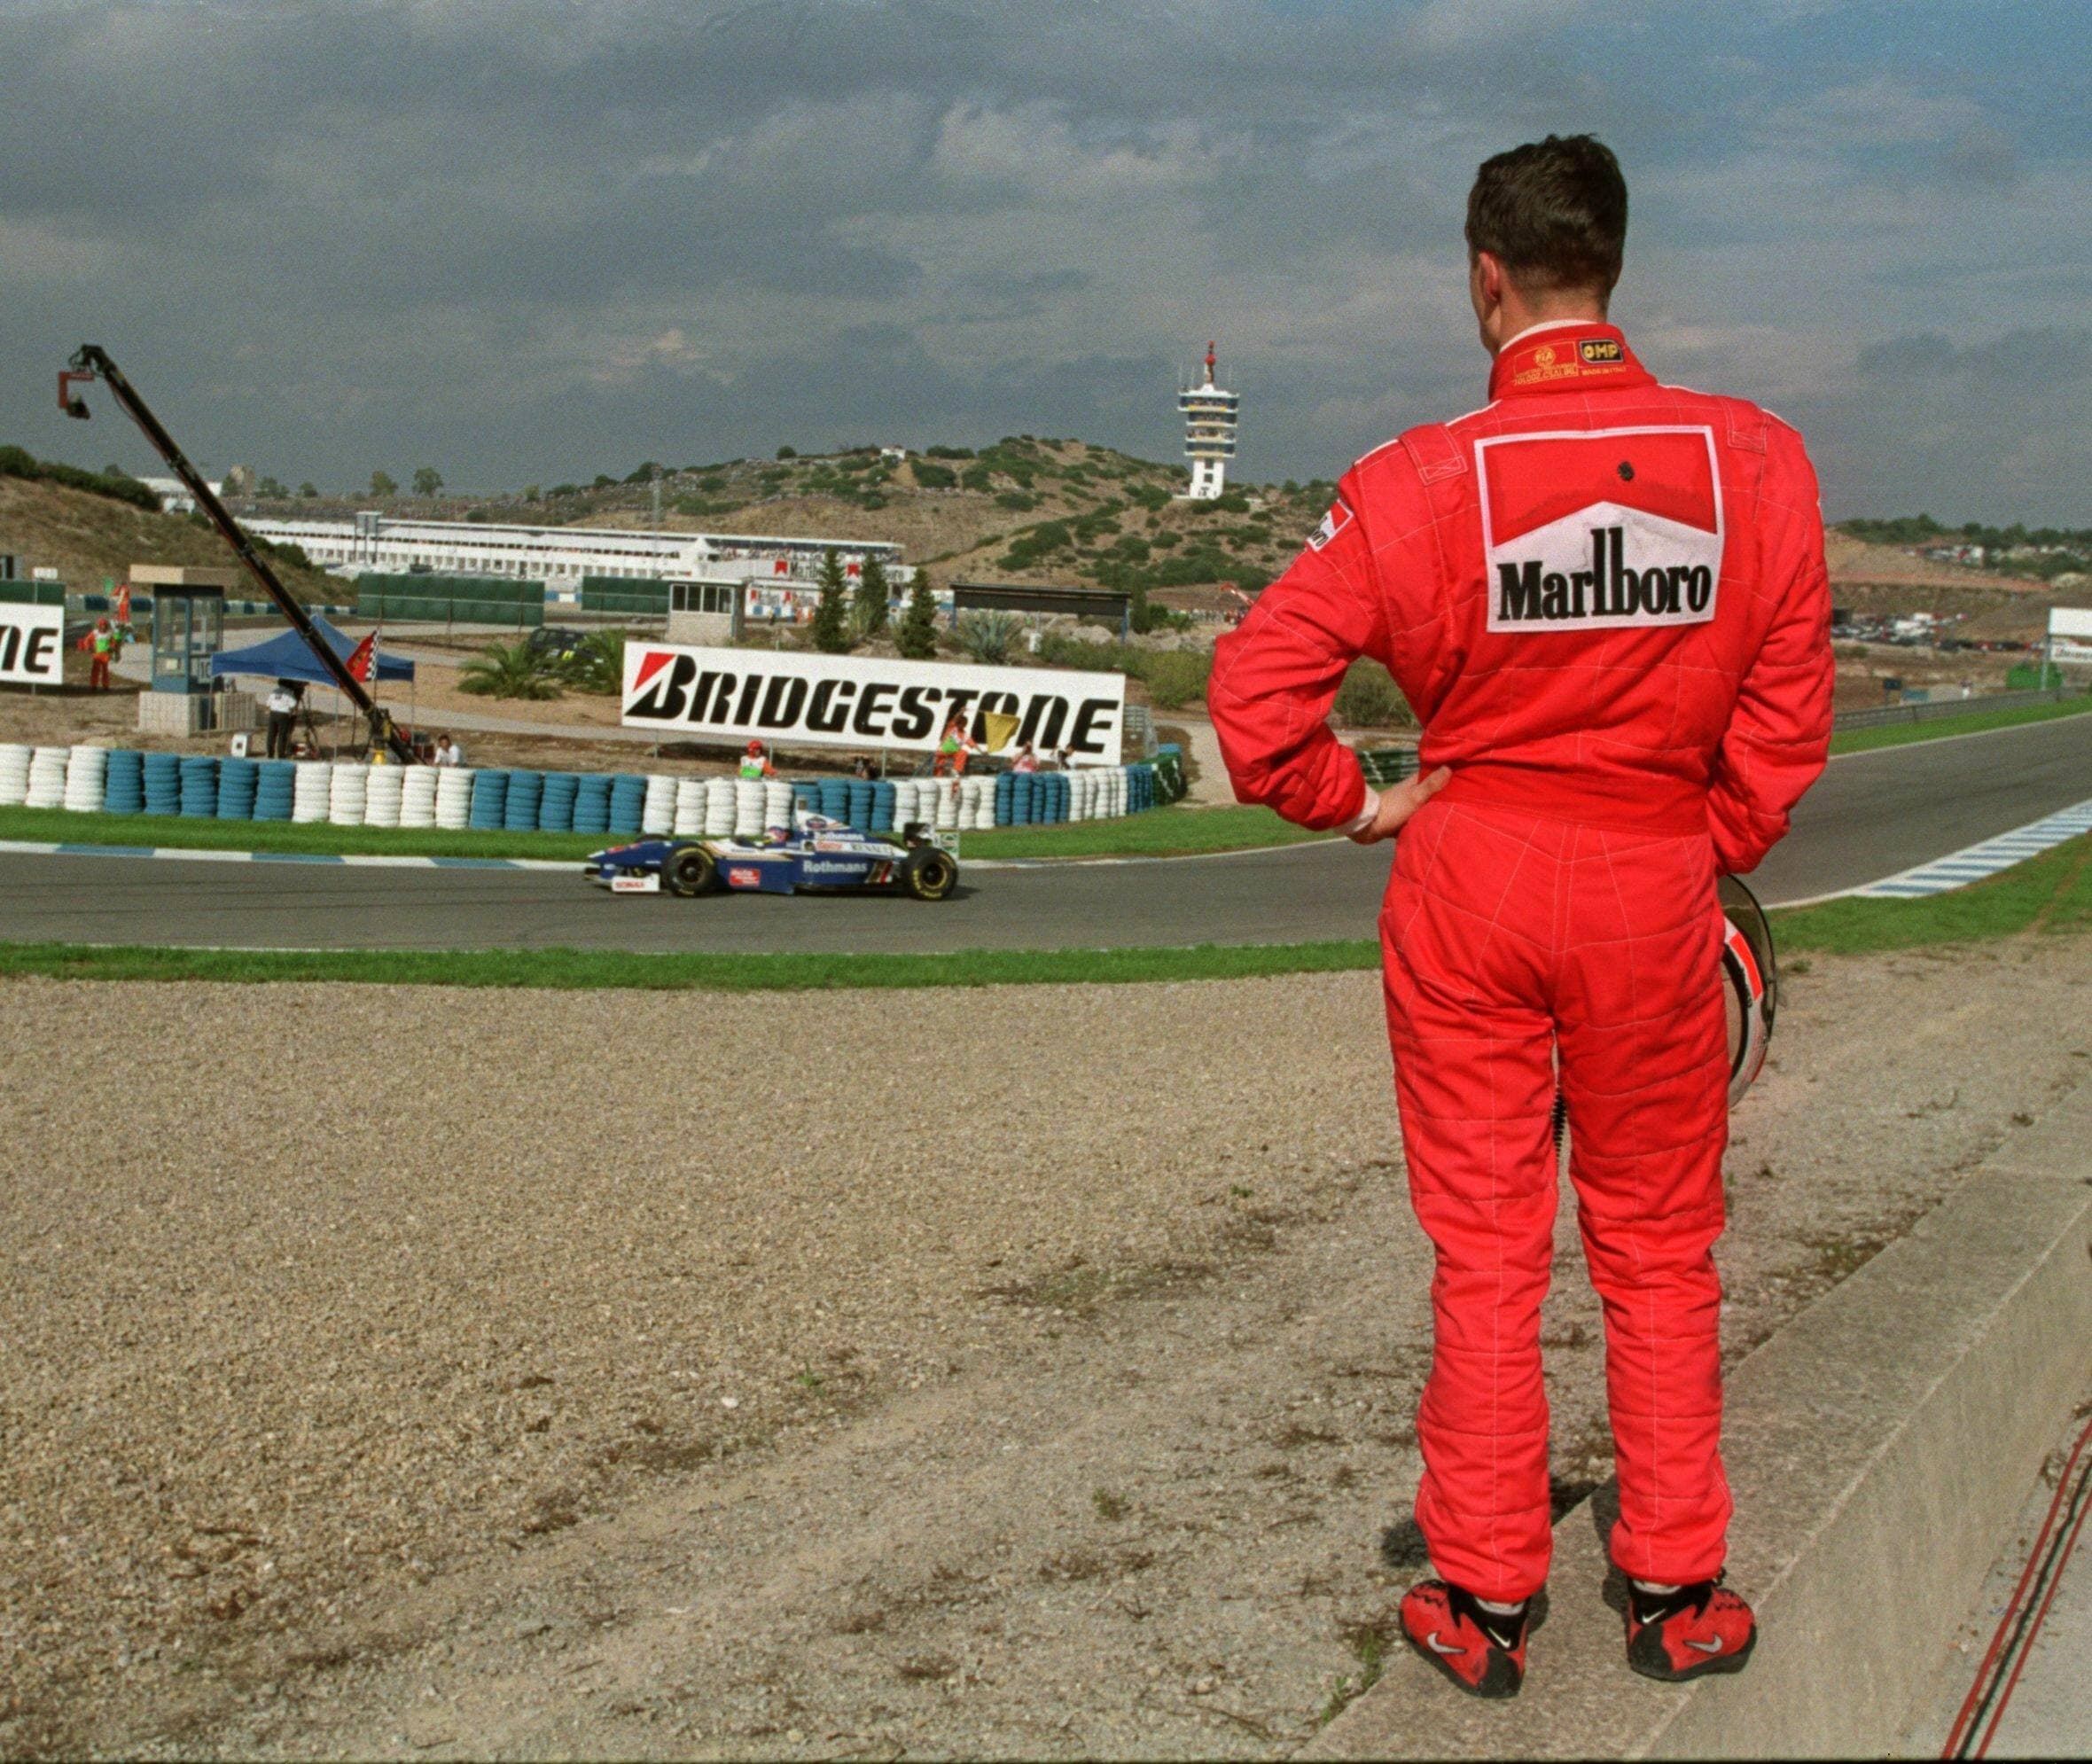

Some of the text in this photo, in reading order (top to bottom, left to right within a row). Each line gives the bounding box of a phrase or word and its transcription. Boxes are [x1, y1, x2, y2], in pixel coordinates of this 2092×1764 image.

[1583, 344, 1619, 359] OMP
[1497, 527, 1712, 621] Marlboro
[625, 653, 1119, 754] BRIDGESTONE
[803, 860, 868, 873] Rothmans
